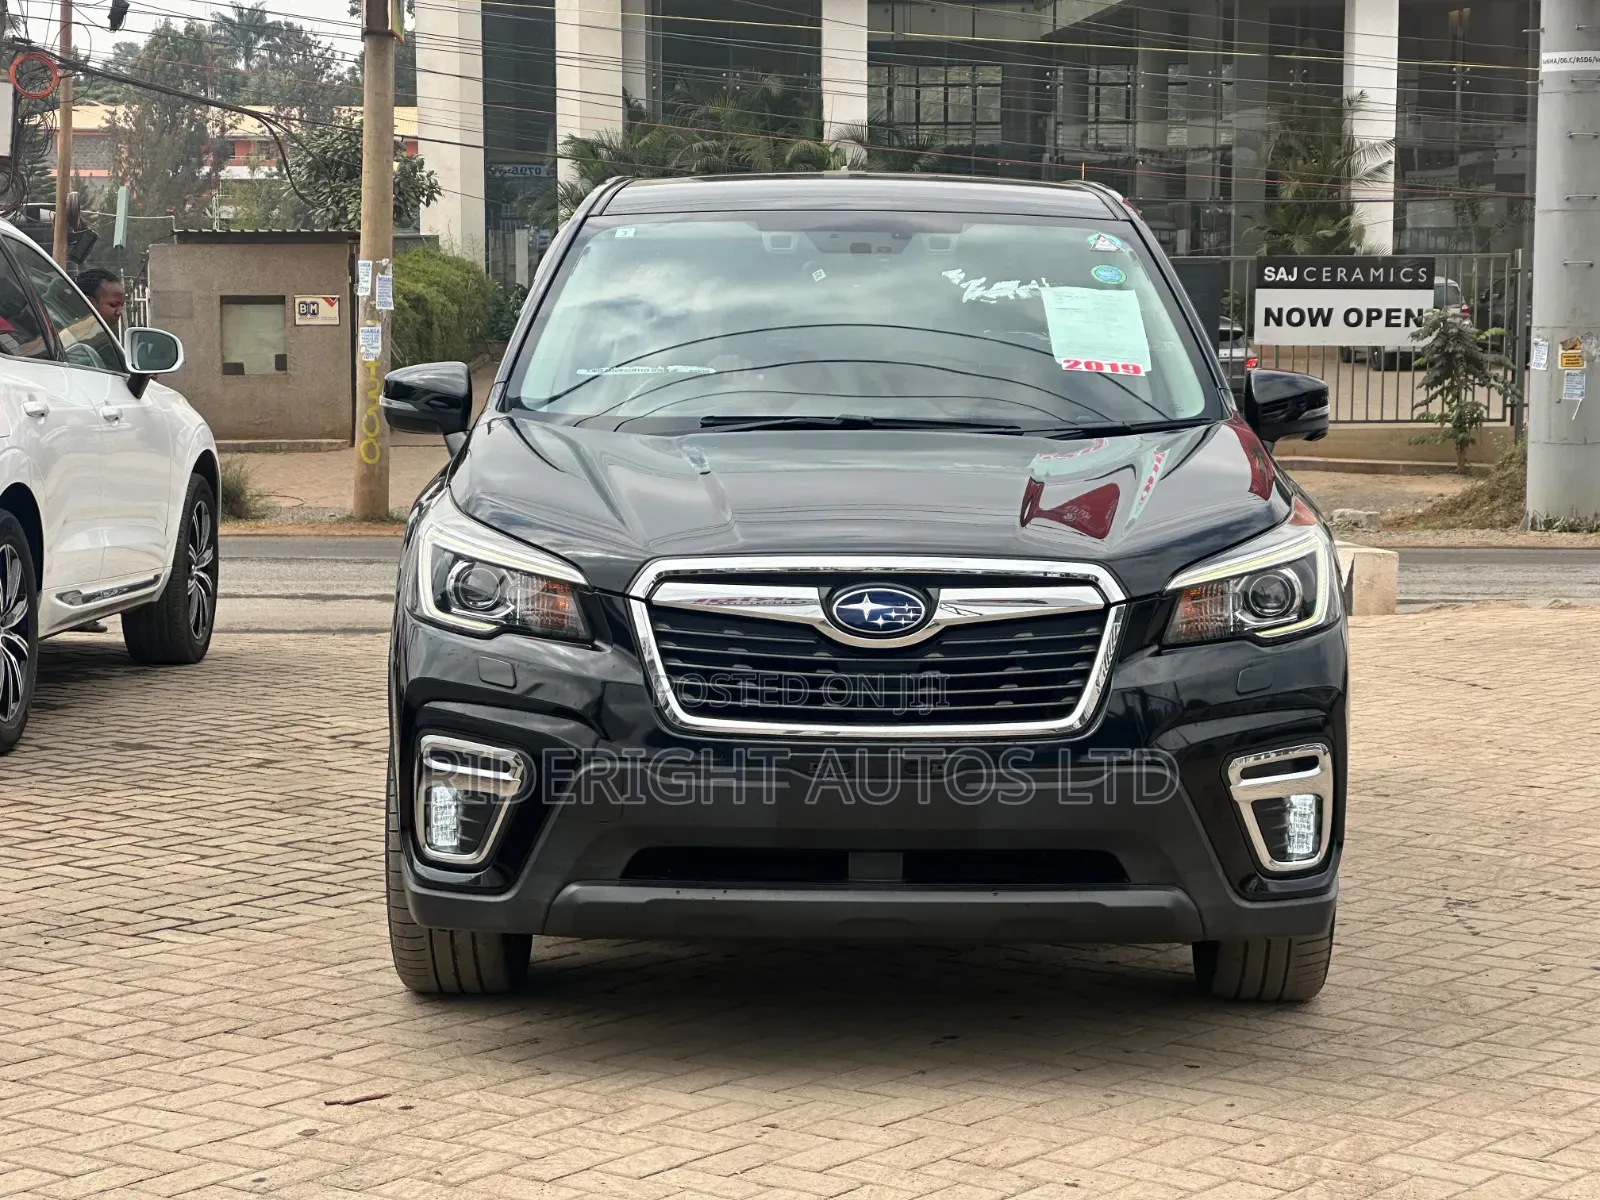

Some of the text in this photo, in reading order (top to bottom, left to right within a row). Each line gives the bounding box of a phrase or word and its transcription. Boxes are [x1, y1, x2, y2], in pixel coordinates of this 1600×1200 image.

[1264, 267, 1427, 282] SAJ CERAMICS
[1264, 307, 1424, 328] NOW OPEN
[1062, 359, 1142, 375] 2019
